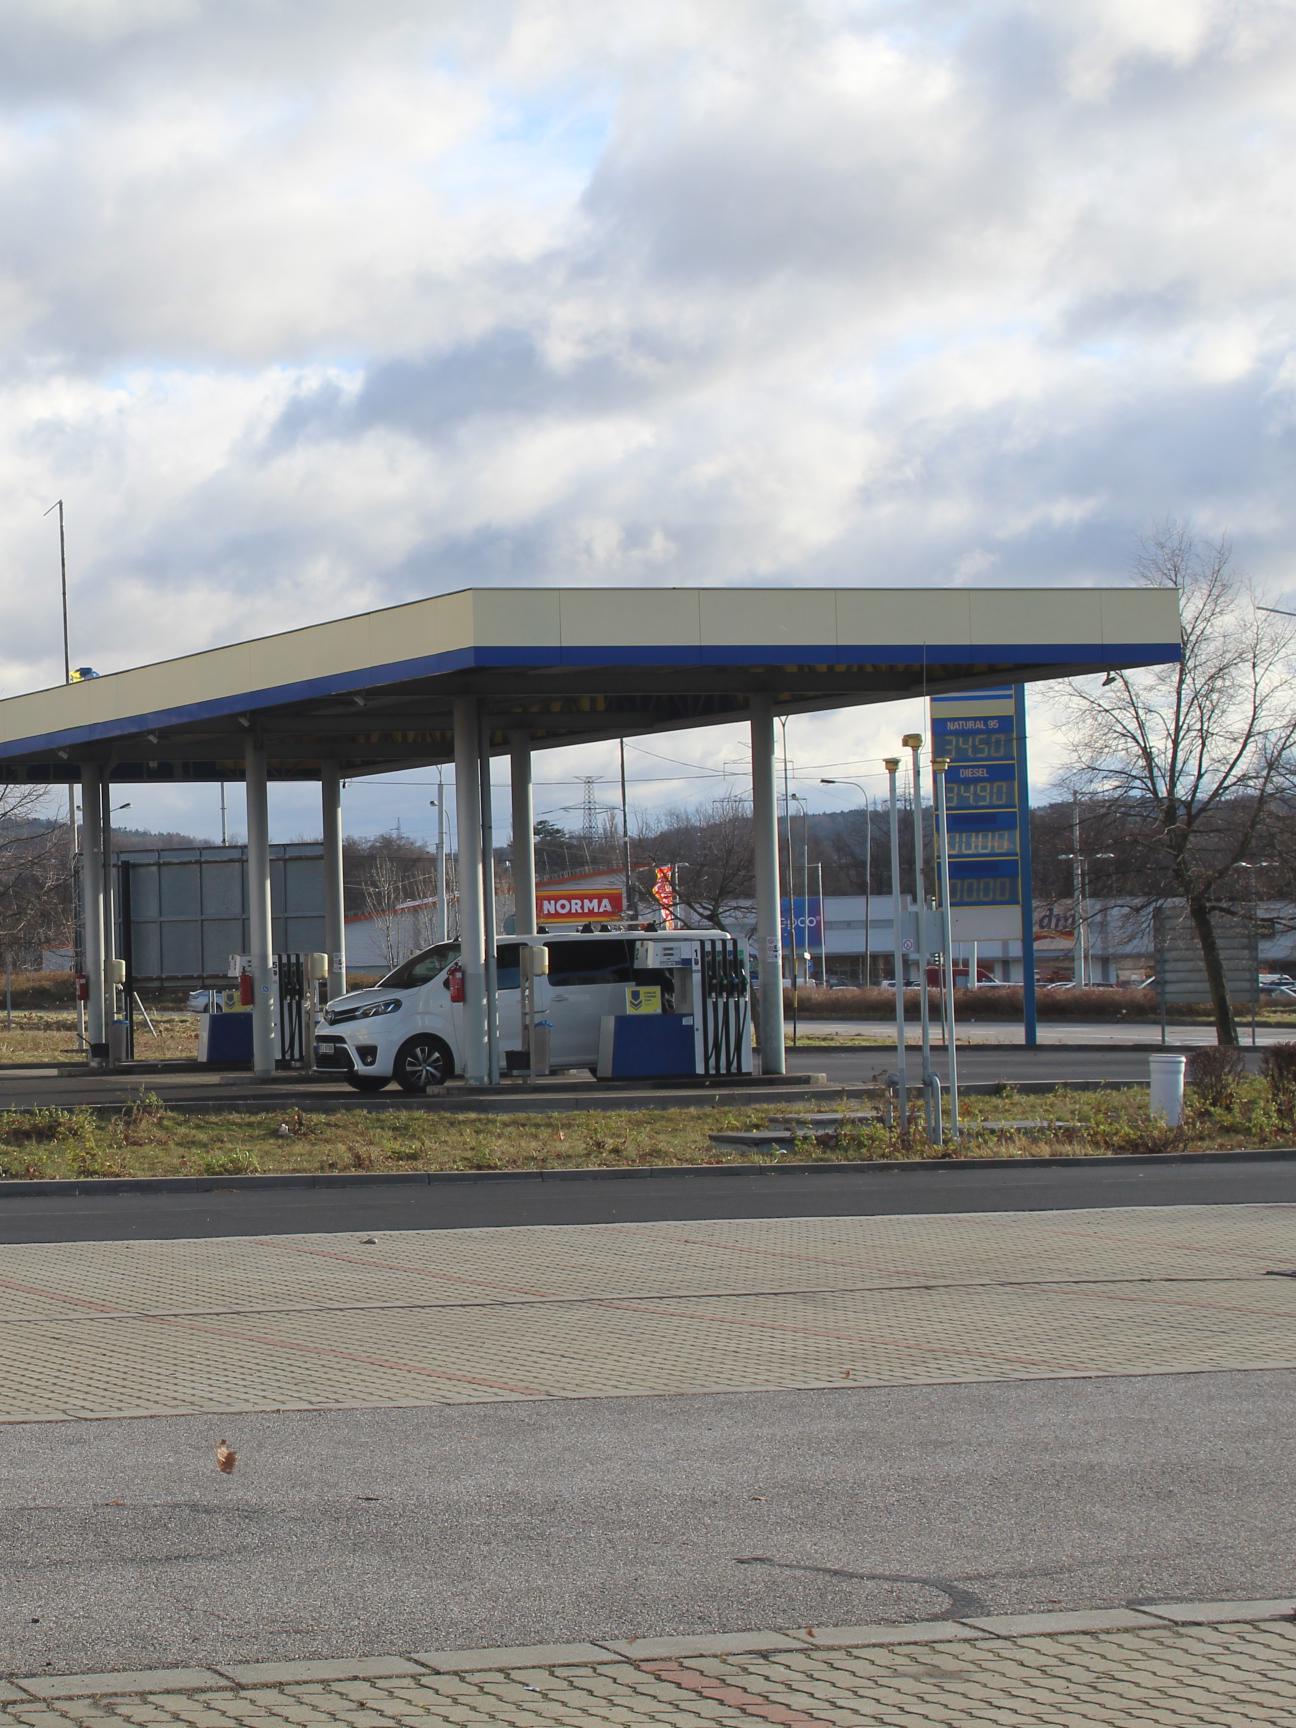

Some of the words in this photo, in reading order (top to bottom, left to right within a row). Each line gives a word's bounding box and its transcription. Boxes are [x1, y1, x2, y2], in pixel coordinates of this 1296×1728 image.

[947, 719, 986, 730] NATURAL
[988, 719, 999, 729] 95
[959, 768, 989, 778] DIESEL
[543, 897, 613, 914] NORMA
[272, 961, 278, 969] 5
